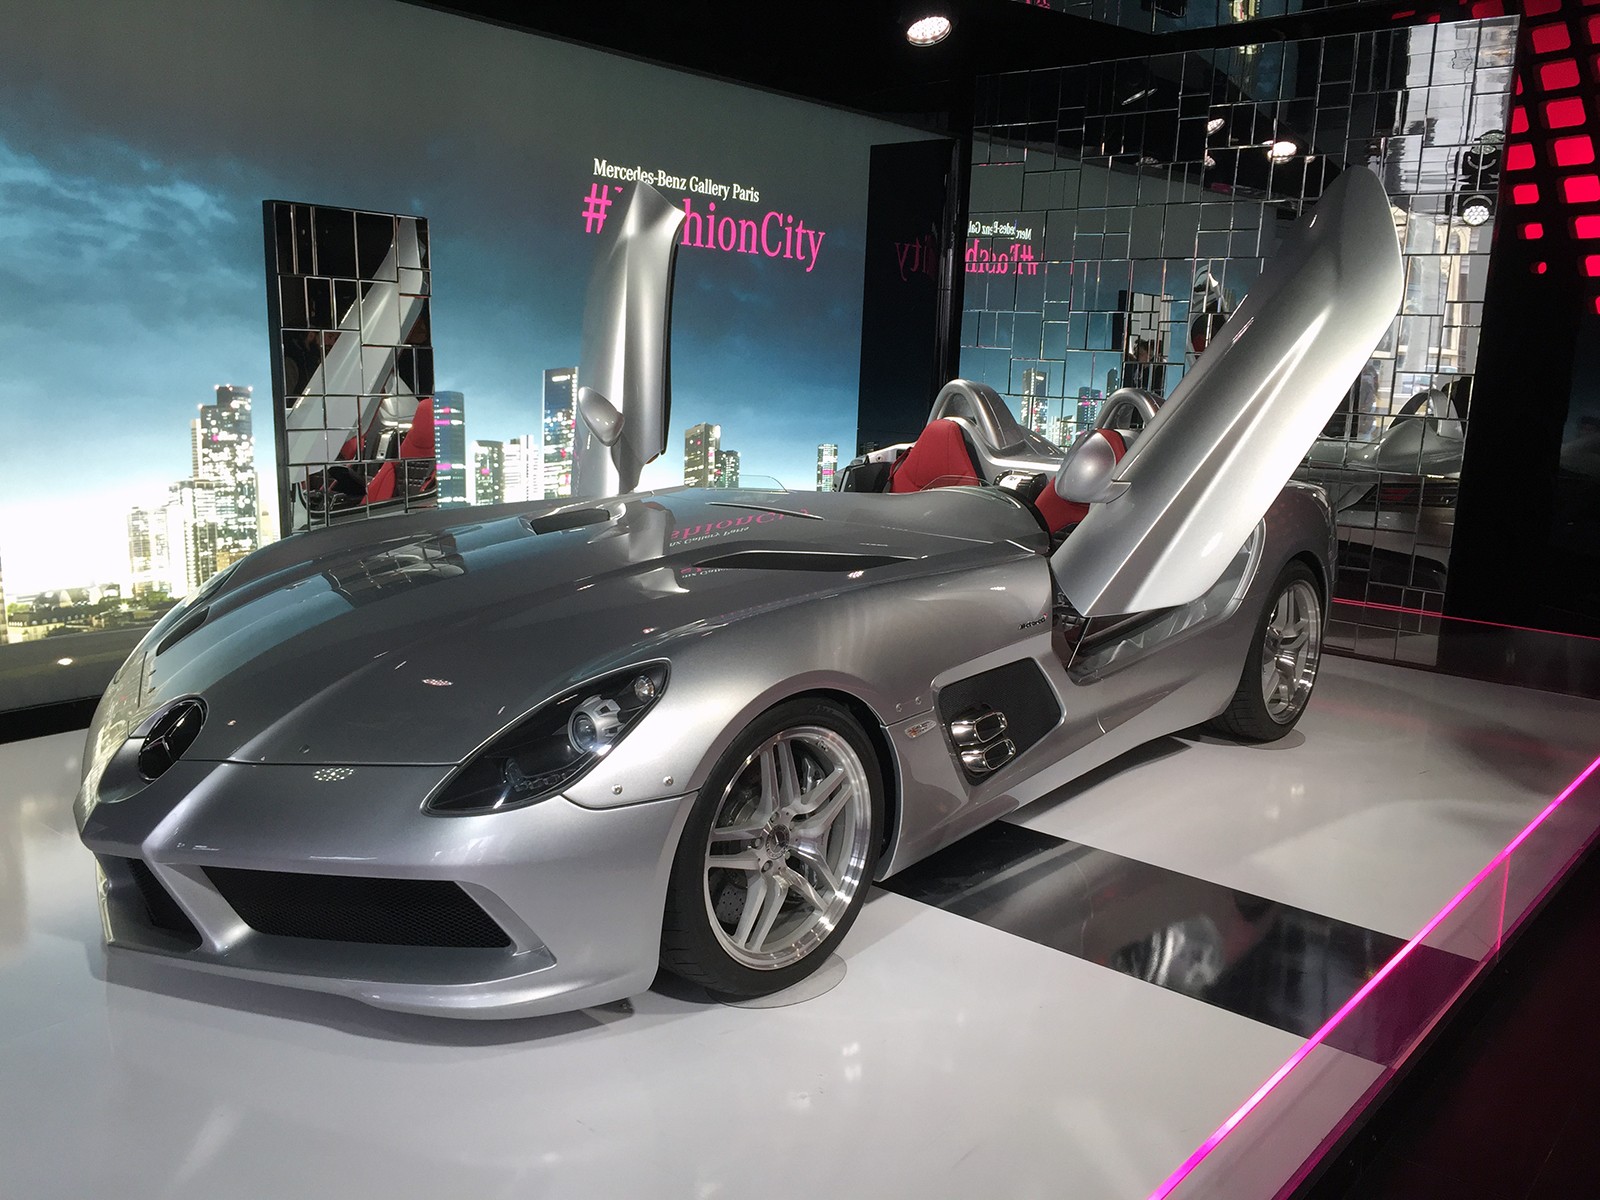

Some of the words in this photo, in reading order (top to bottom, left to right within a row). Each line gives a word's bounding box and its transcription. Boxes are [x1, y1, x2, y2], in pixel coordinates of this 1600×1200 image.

[593, 158, 687, 191] Mercedes-Benz
[689, 176, 730, 201] Gallery
[732, 183, 760, 203] Paris
[582, 183, 826, 273] #hionCity
